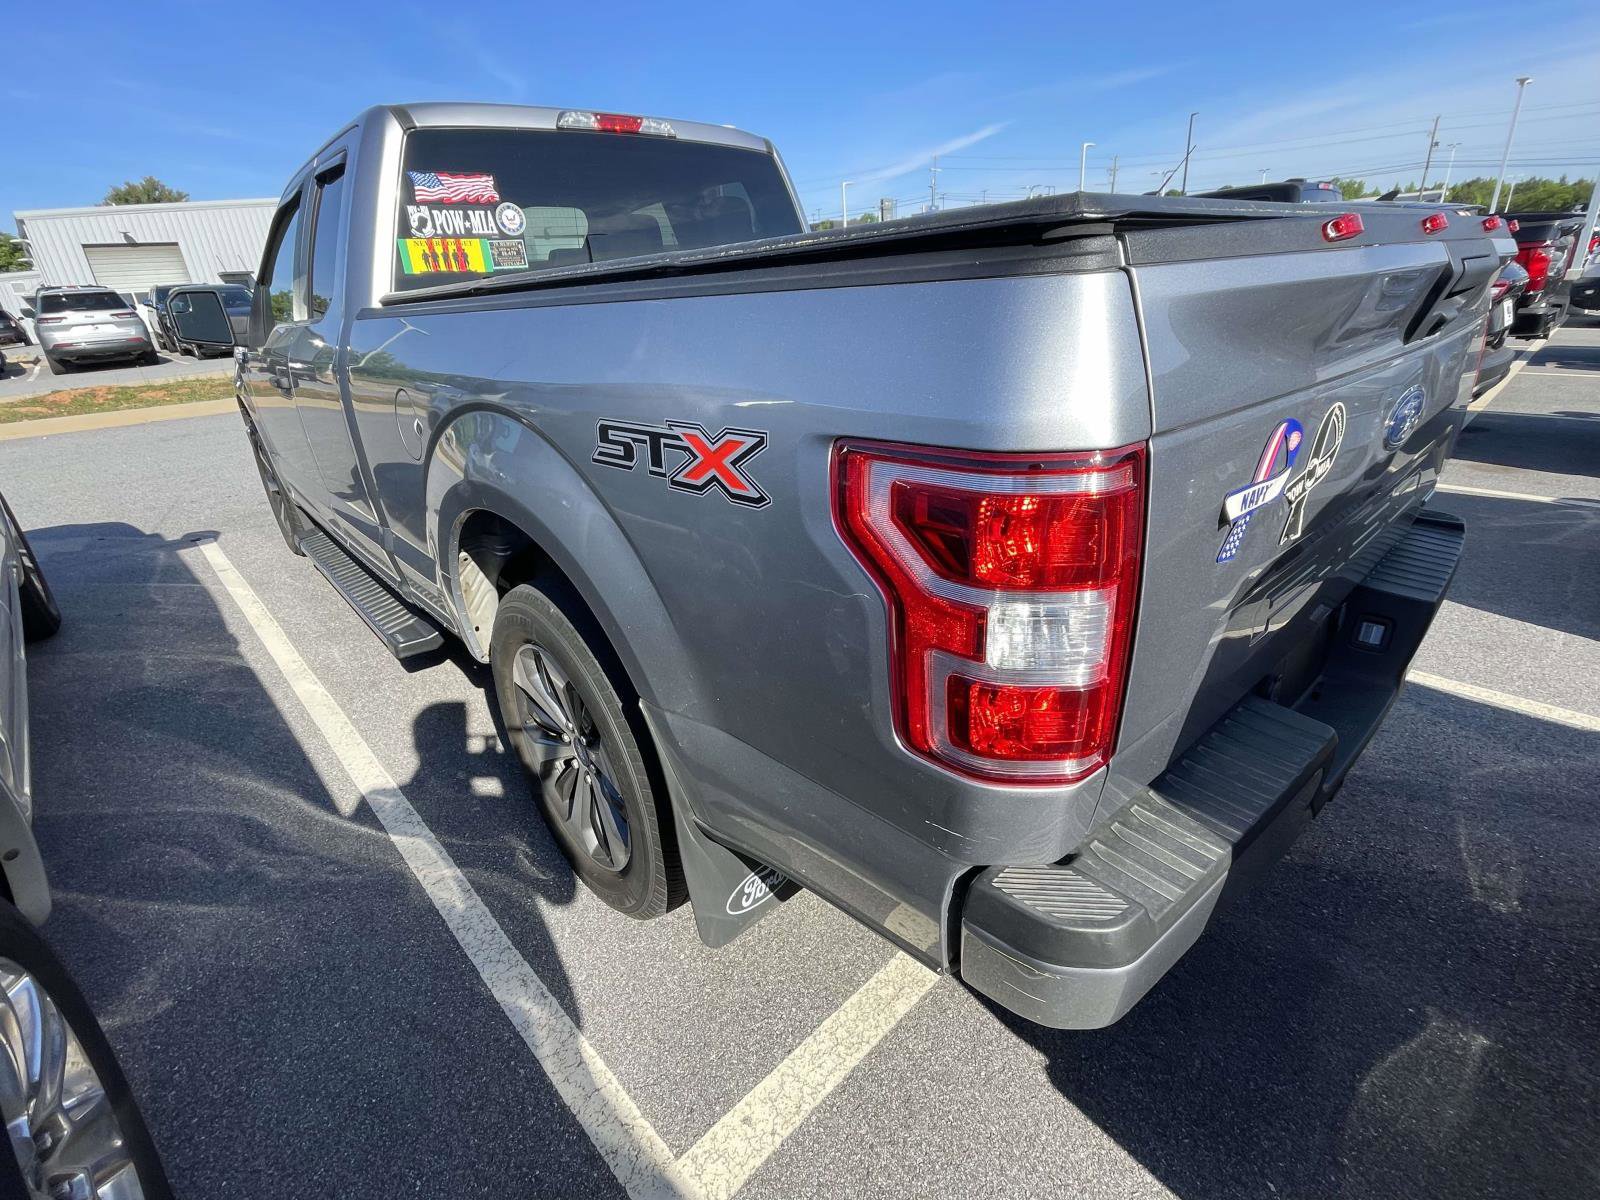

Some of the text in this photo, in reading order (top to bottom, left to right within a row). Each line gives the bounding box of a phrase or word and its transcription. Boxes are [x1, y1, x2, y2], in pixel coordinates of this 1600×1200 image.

[432, 209, 465, 235] POW
[468, 210, 499, 234] MIA
[592, 417, 773, 511] STX
[1240, 482, 1273, 512] NAVY
